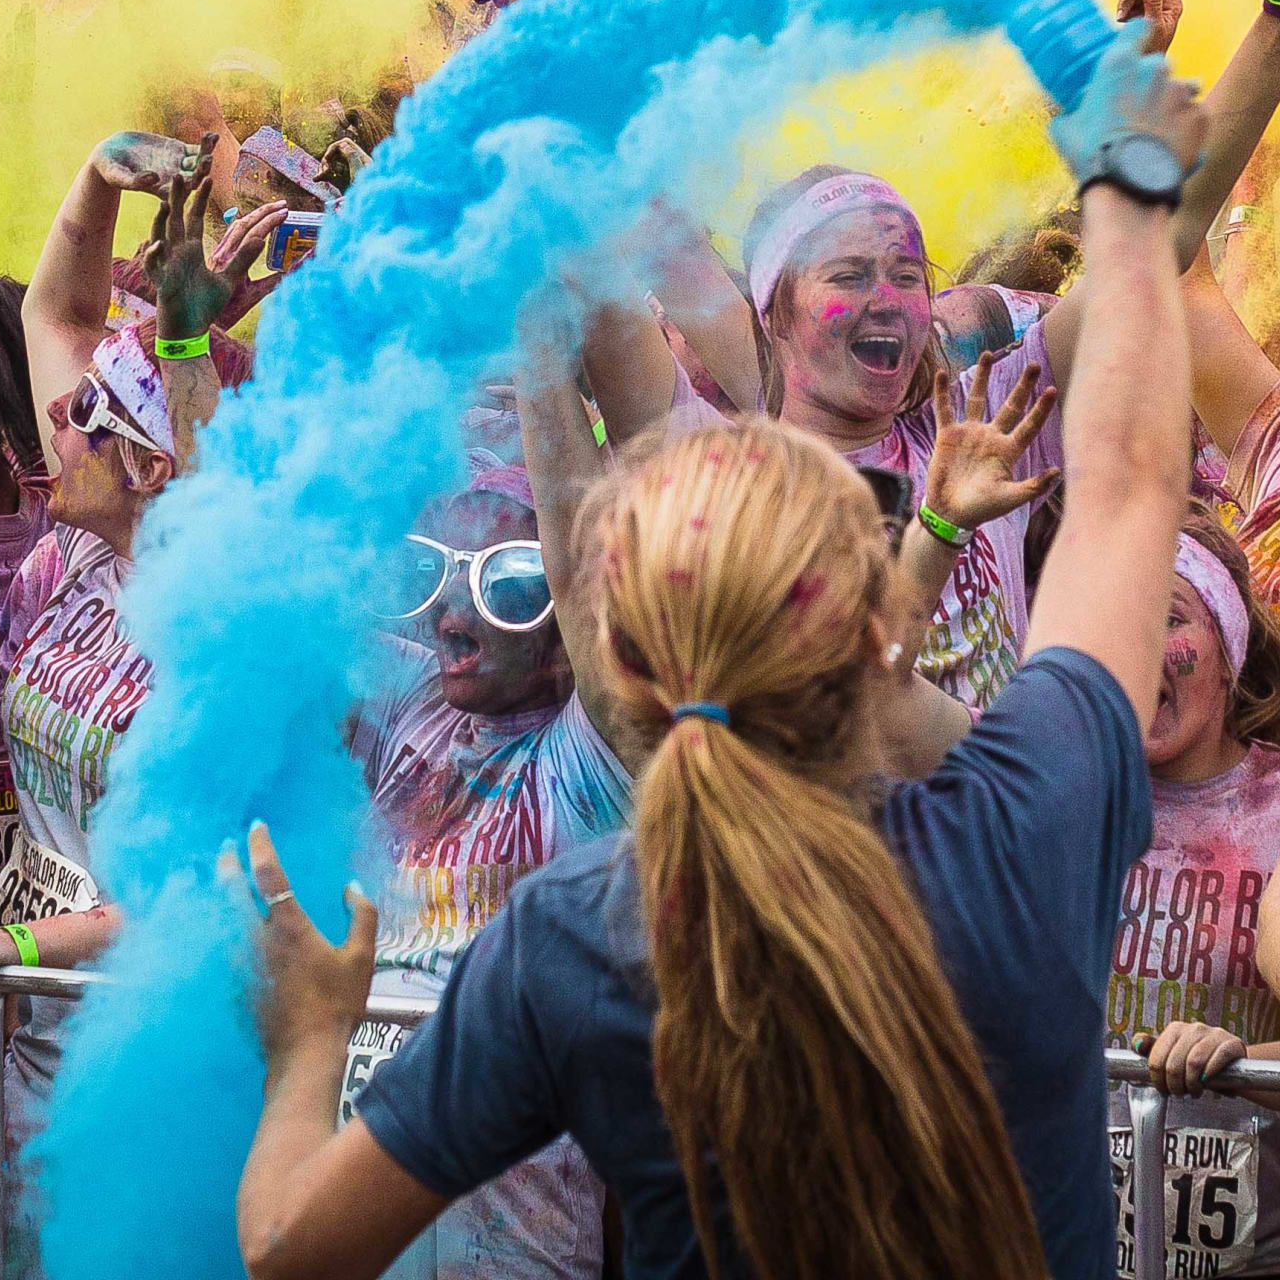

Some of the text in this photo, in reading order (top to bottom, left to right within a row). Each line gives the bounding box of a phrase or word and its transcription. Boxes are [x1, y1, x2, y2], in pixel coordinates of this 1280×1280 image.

[26, 641, 111, 719] COLOR
[9, 683, 81, 771] COLOR
[28, 848, 58, 891] COLOR
[1122, 859, 1225, 925] OLOR
[1113, 917, 1217, 985] OLOR
[1107, 973, 1211, 1036] OLOR
